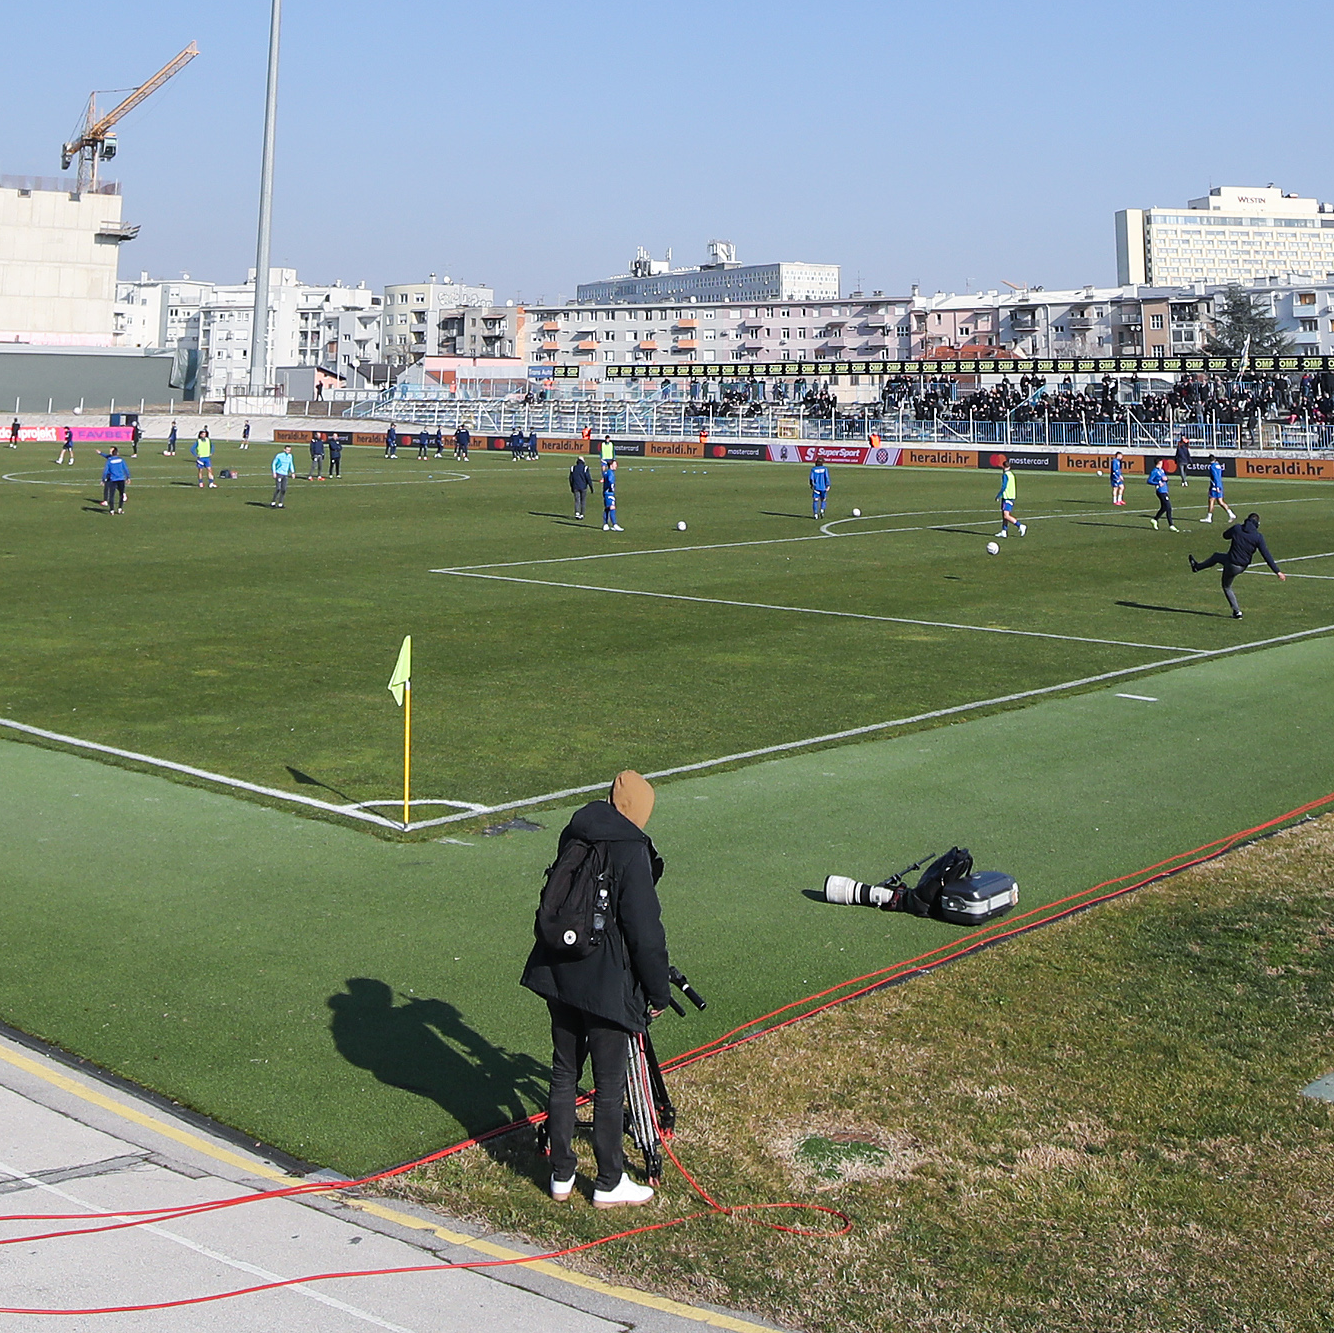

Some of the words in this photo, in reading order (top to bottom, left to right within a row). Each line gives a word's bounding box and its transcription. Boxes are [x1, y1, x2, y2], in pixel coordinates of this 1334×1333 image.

[1237, 196, 1266, 204] WESTIN
[1038, 362, 1053, 370] OMP
[1058, 362, 1074, 370] OMP
[1078, 362, 1095, 370] OMP
[1120, 361, 1137, 369] OMP
[1142, 361, 1159, 369] OMP
[1164, 361, 1181, 369] OMP
[1186, 360, 1204, 369] OMP
[1209, 360, 1226, 368] OMP
[1255, 360, 1274, 368] OMP
[1279, 359, 1298, 368] OMP
[1304, 359, 1322, 368] OMP
[78, 430, 131, 438] FAVBET
[277, 432, 308, 441] heraldi.hr
[356, 434, 387, 444] heraldi.h
[542, 440, 584, 450] heraldi.hr
[651, 443, 698, 455] heraldi.hr
[727, 448, 760, 456] mastercard
[817, 447, 860, 457] SuperSport
[910, 451, 970, 464] heraldi.hr
[1008, 457, 1049, 466] mastercard
[1067, 455, 1135, 469] heraldhr
[1246, 460, 1324, 476] heraldi.hr
